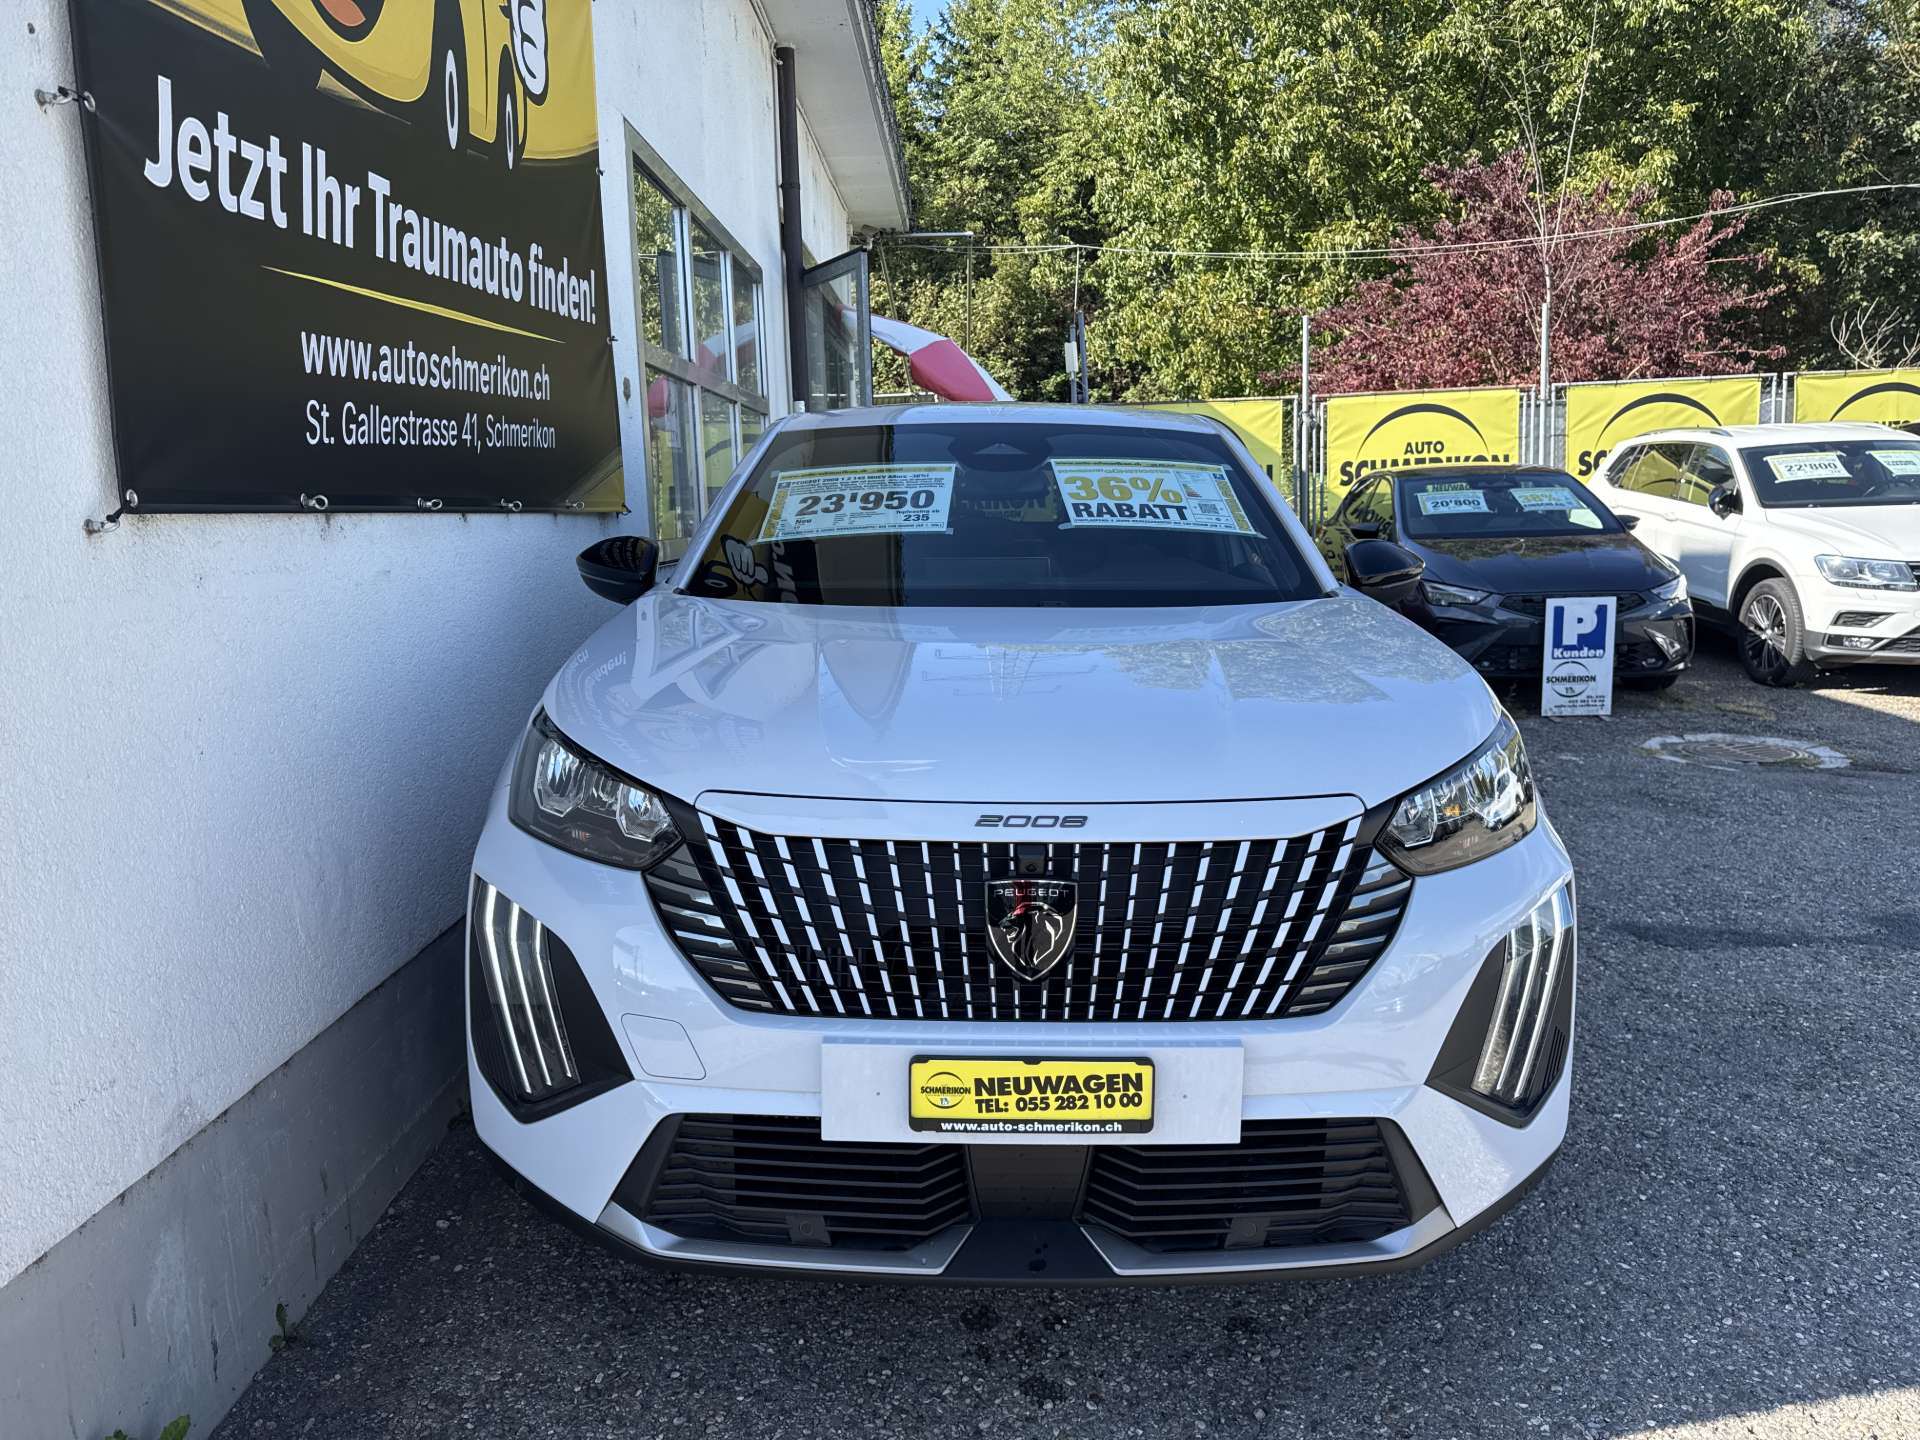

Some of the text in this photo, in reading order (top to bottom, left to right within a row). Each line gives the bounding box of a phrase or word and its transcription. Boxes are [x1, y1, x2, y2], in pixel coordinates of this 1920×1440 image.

[143, 74, 596, 325] Jetzt Ihr Traumauto finden!
[301, 331, 551, 401] www.autoschmerikon.ch
[305, 399, 556, 454] St. Gallerstrasse 41, Schmerikon
[1404, 441, 1445, 455] AUTO
[1063, 476, 1183, 504] 36%
[795, 489, 935, 517] 23'950
[1431, 499, 1481, 509] 20'800
[903, 514, 930, 522] 235
[1071, 502, 1187, 521] RABATT
[1553, 647, 1604, 659] Kunden
[1546, 675, 1597, 684] SCHMERIKON
[975, 815, 1088, 828] 2008
[994, 888, 1069, 897] PEUGEOT
[921, 1086, 972, 1095] SCHMERIKON
[973, 1073, 1143, 1097] NEUWAGEN
[975, 1092, 1143, 1114] TEL: 055 282 10 00
[941, 1121, 1122, 1132] www.auto-schmerikon.ch
